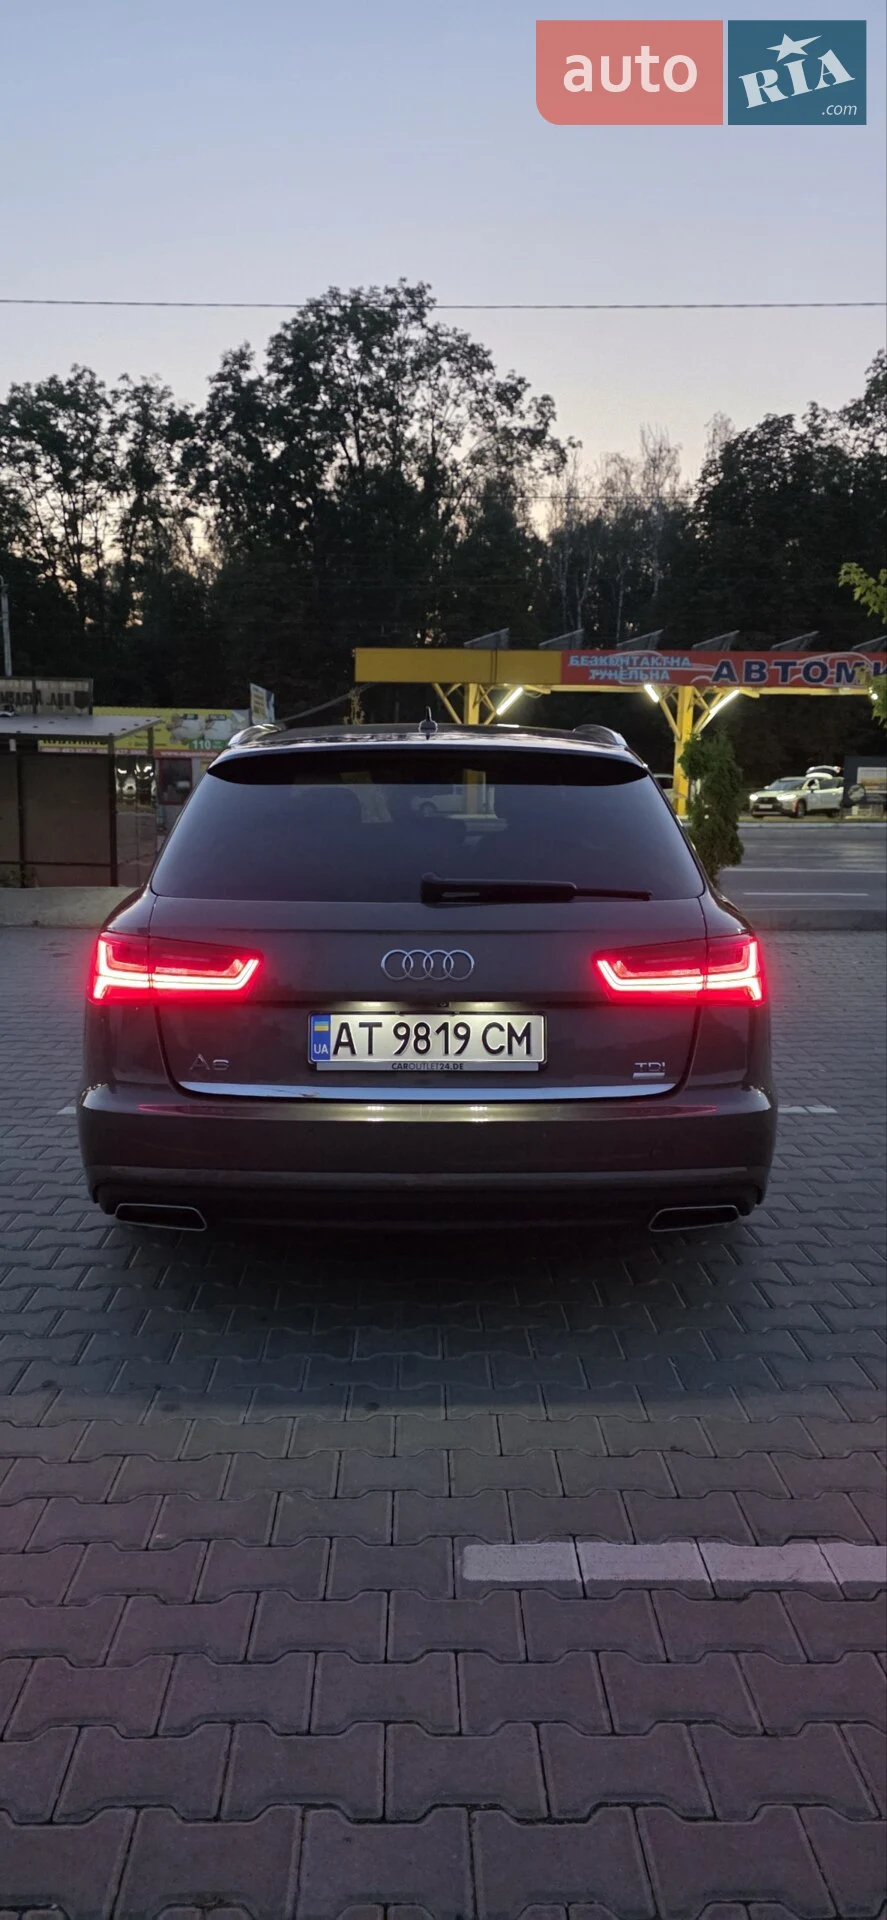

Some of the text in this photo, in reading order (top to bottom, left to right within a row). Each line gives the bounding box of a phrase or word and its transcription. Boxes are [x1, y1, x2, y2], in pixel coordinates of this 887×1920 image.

[569, 655, 692, 667] БЕЗКОНТАКТНА
[589, 669, 670, 681] ТУНЕЛЬНА
[192, 739, 212, 750] 110
[332, 1021, 532, 1056] AT 9819 CM
[313, 1043, 329, 1055] UA
[189, 1053, 230, 1071] A6
[391, 1062, 464, 1070] CAROUTLET24.DE
[634, 1061, 666, 1072] TDI
